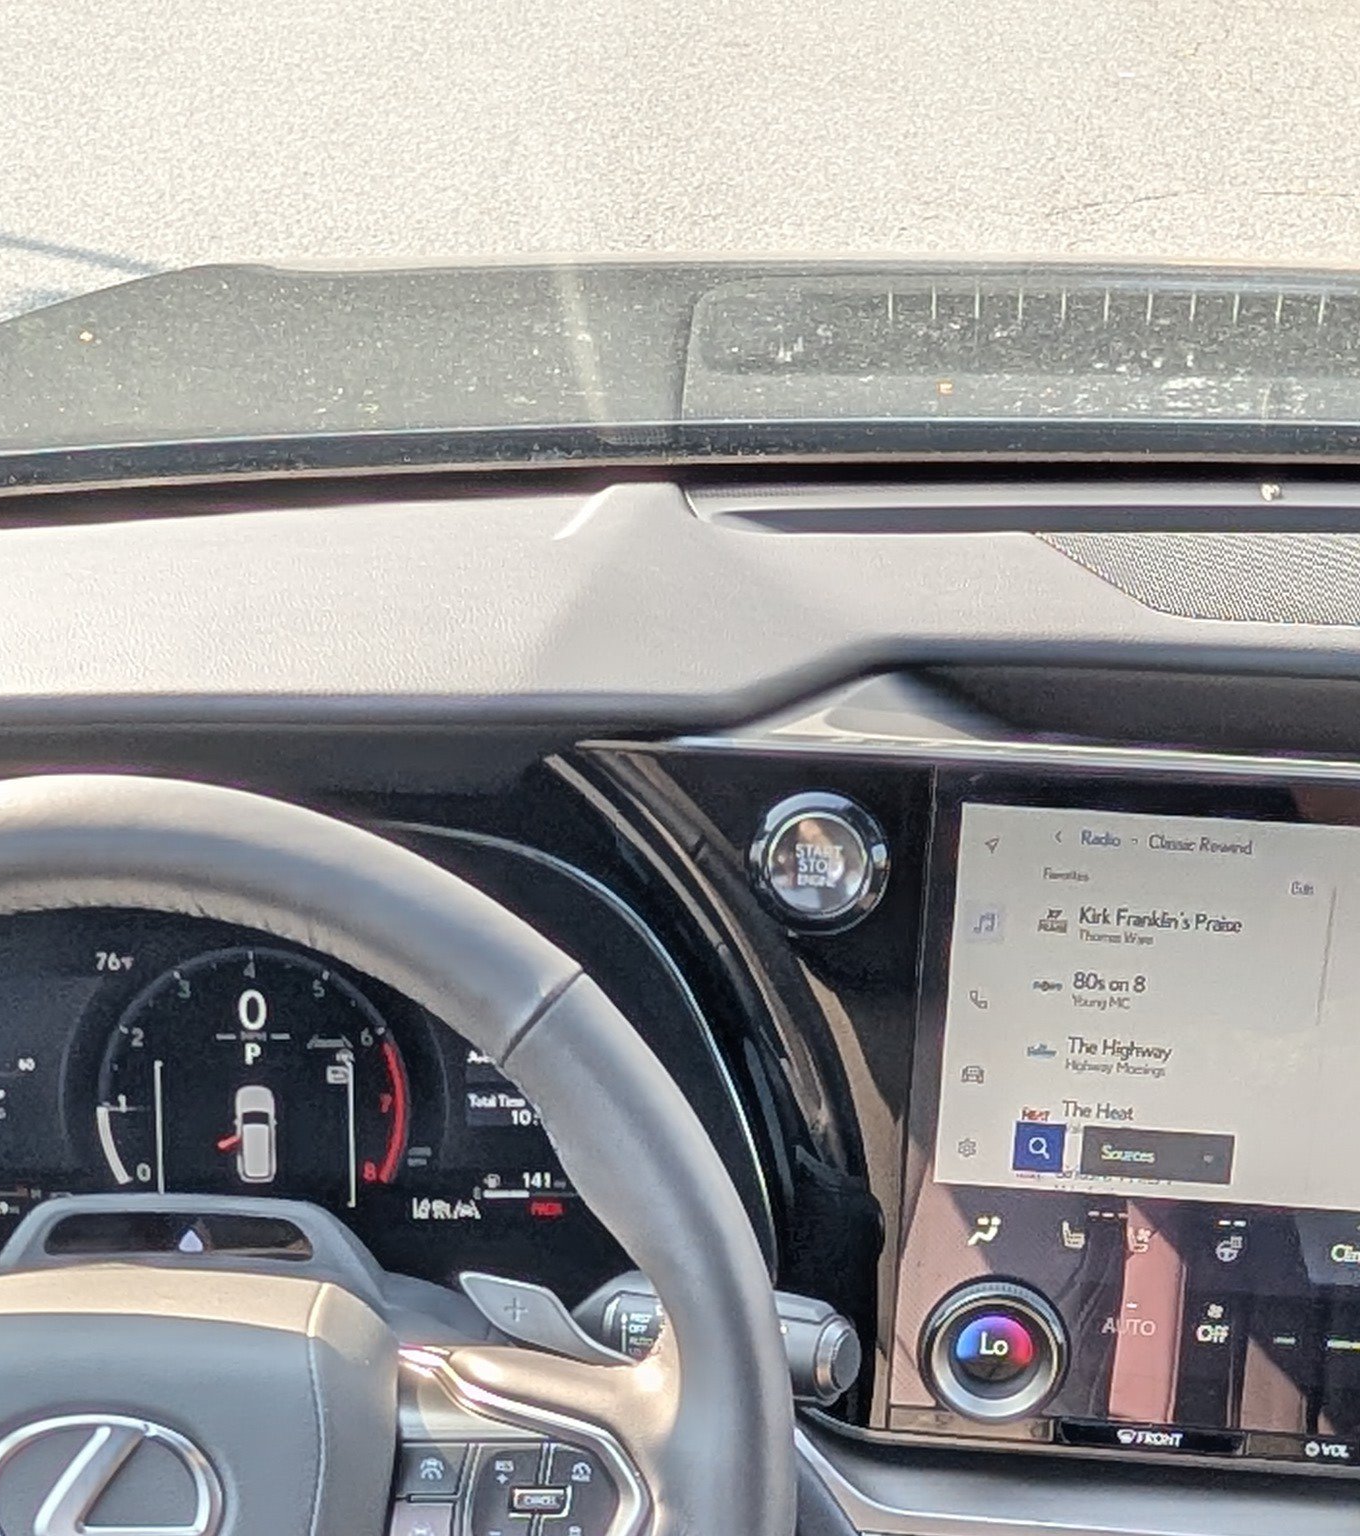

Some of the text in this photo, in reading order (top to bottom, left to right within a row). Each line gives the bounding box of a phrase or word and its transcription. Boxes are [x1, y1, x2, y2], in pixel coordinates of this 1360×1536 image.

[1081, 831, 1122, 847] Radio
[796, 844, 844, 859] START
[1079, 907, 1111, 925] Kirk
[1115, 909, 1190, 931] Franklin's
[1195, 914, 1243, 934] Praise
[1073, 971, 1105, 991] 80s
[1109, 978, 1130, 992] on
[1133, 976, 1147, 993] 8
[239, 989, 267, 1030] 0
[1109, 996, 1130, 1009] MC
[132, 1027, 144, 1047] 2
[361, 1026, 373, 1046] 6
[245, 1043, 261, 1065] P
[1068, 1036, 1098, 1055] The
[1103, 1039, 1172, 1063] Highway
[467, 1092, 526, 1107] Total Time
[1062, 1100, 1134, 1121] The Heat
[1101, 1144, 1156, 1164] Sources
[523, 1172, 551, 1188] 141
[1101, 1316, 1156, 1338] AUTO
[979, 1331, 1009, 1358] Lo
